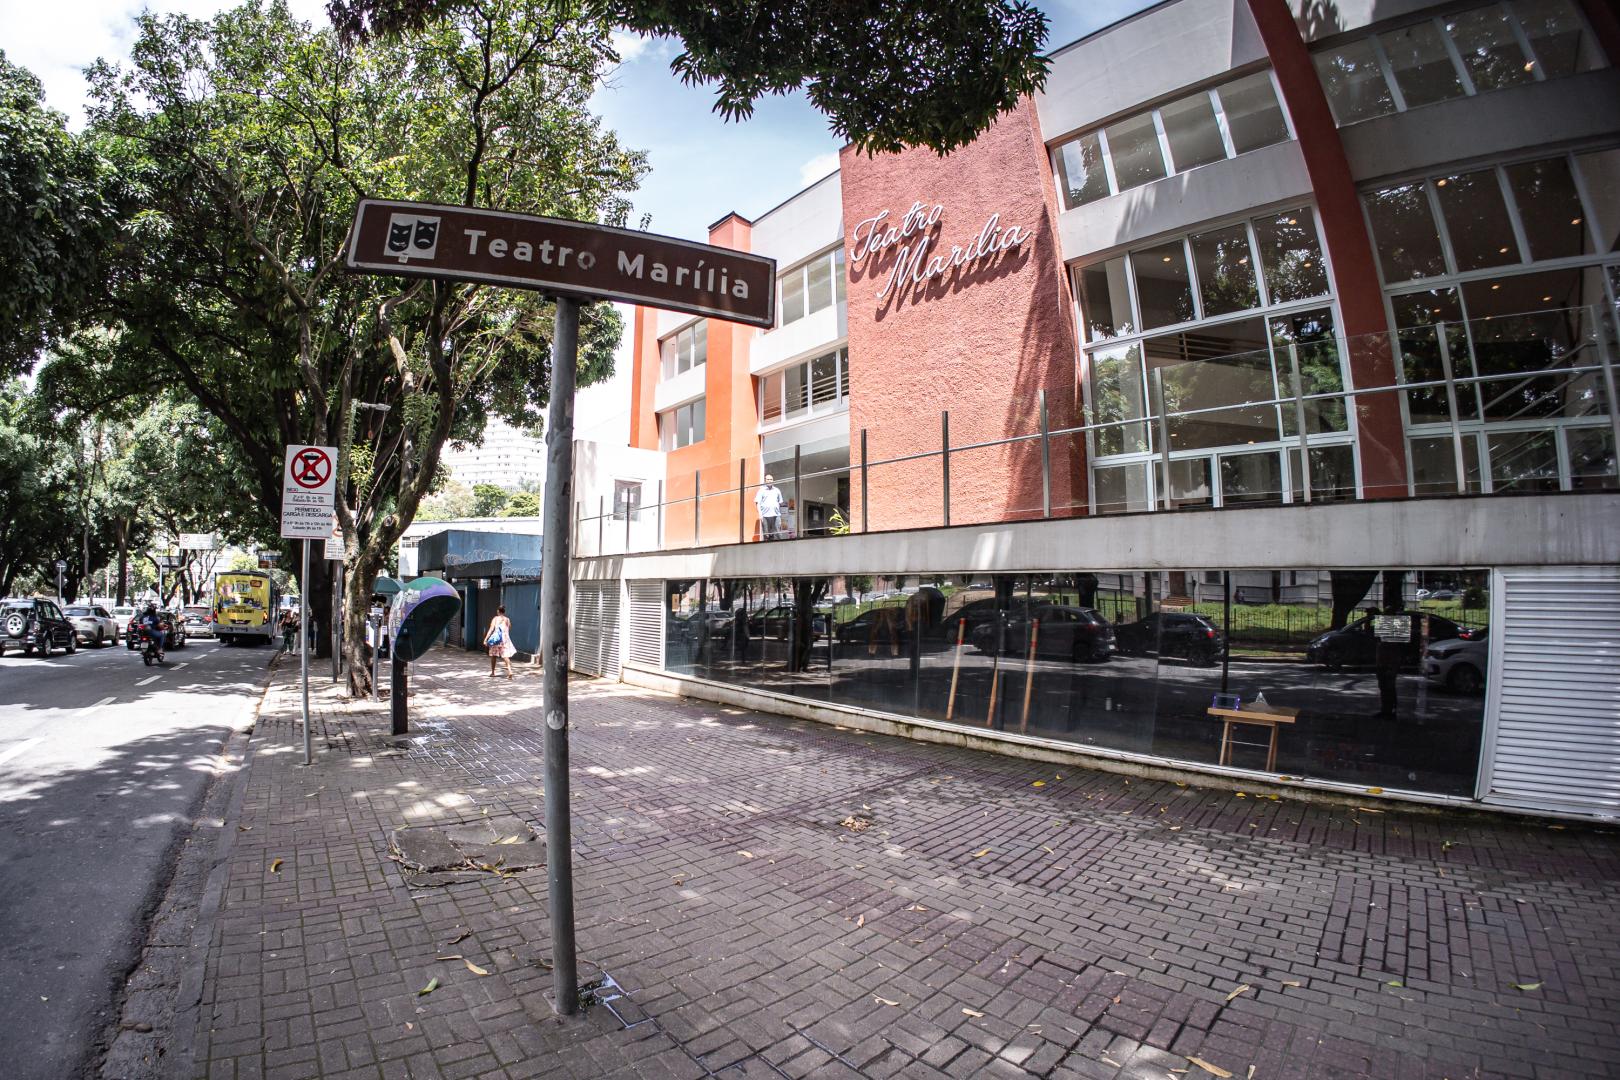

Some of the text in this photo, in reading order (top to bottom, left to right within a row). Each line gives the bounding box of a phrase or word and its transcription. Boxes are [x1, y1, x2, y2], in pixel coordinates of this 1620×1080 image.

[463, 228, 749, 299] Teatro Marília
[850, 200, 944, 262] Teatro
